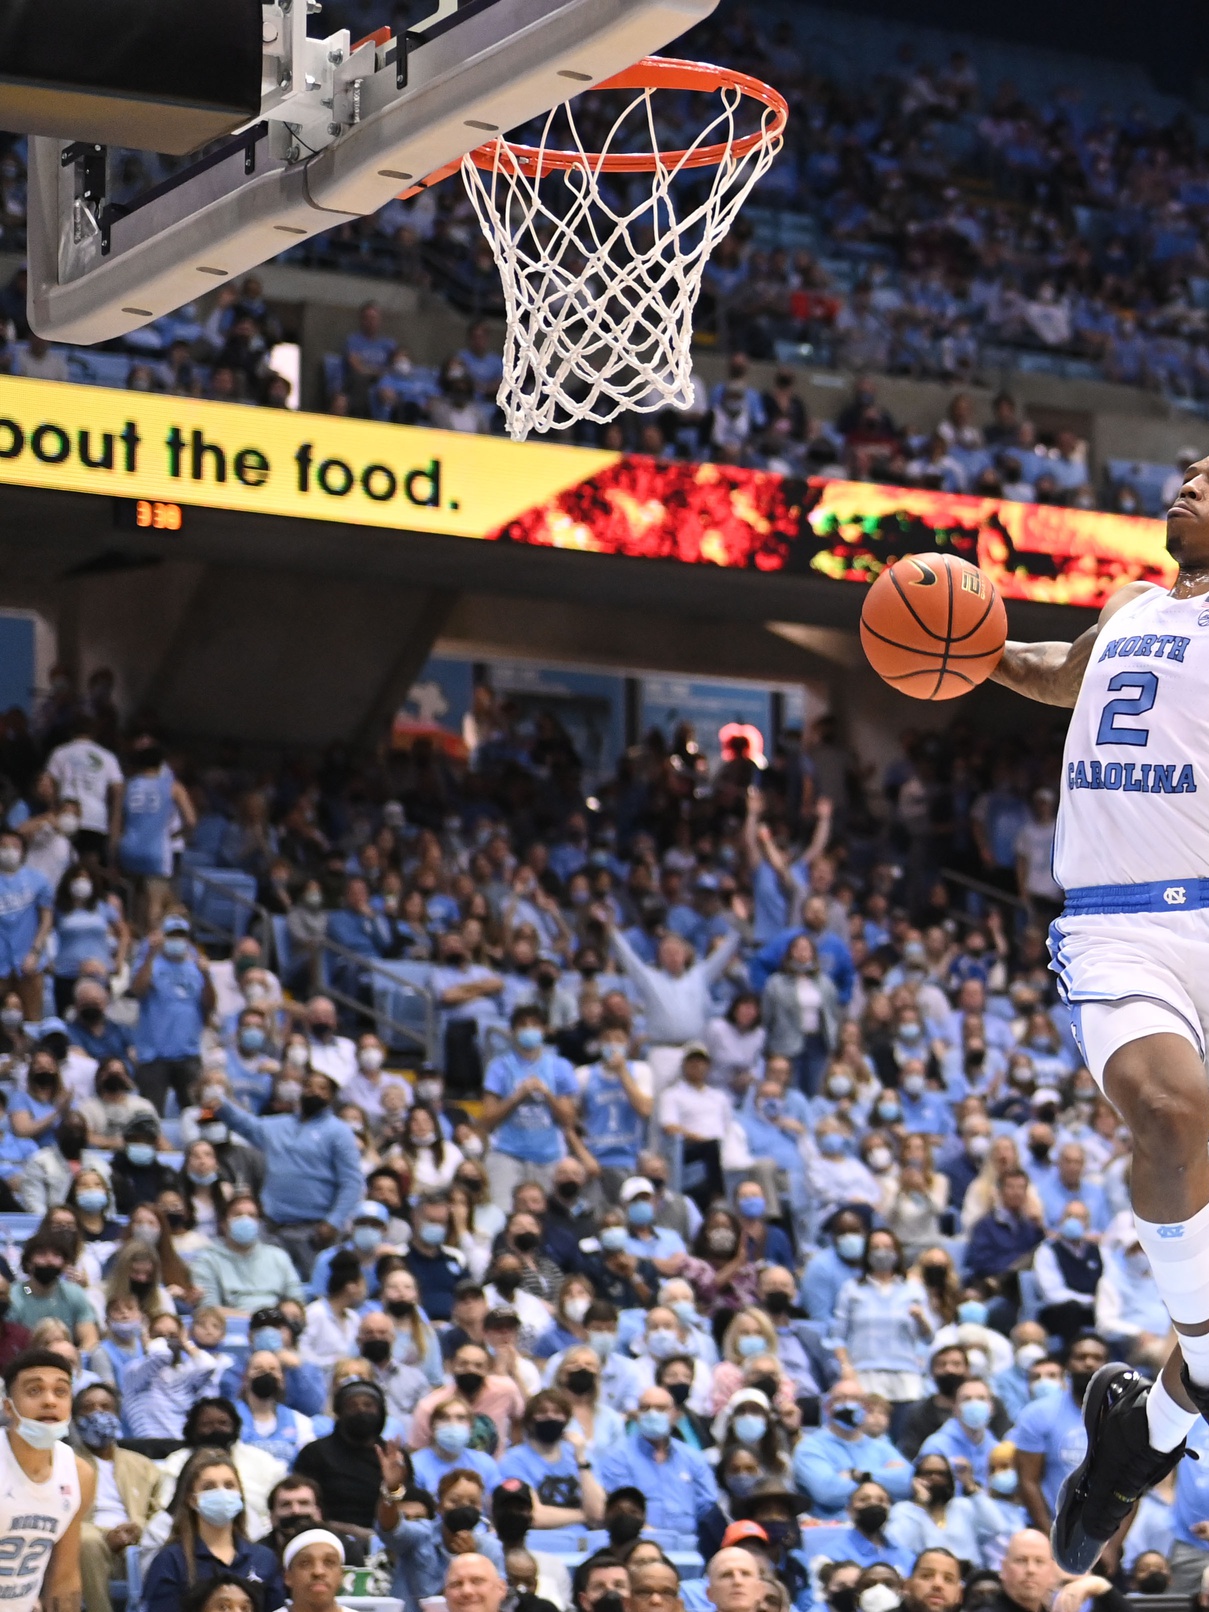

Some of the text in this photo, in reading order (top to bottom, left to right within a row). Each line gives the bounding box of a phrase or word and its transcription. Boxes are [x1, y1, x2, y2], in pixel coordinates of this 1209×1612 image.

[166, 426, 270, 487] the
[296, 442, 460, 511] food.
[1098, 634, 1191, 663] NORTH
[1095, 671, 1159, 747] 2
[1067, 760, 1197, 794] CAROLINA
